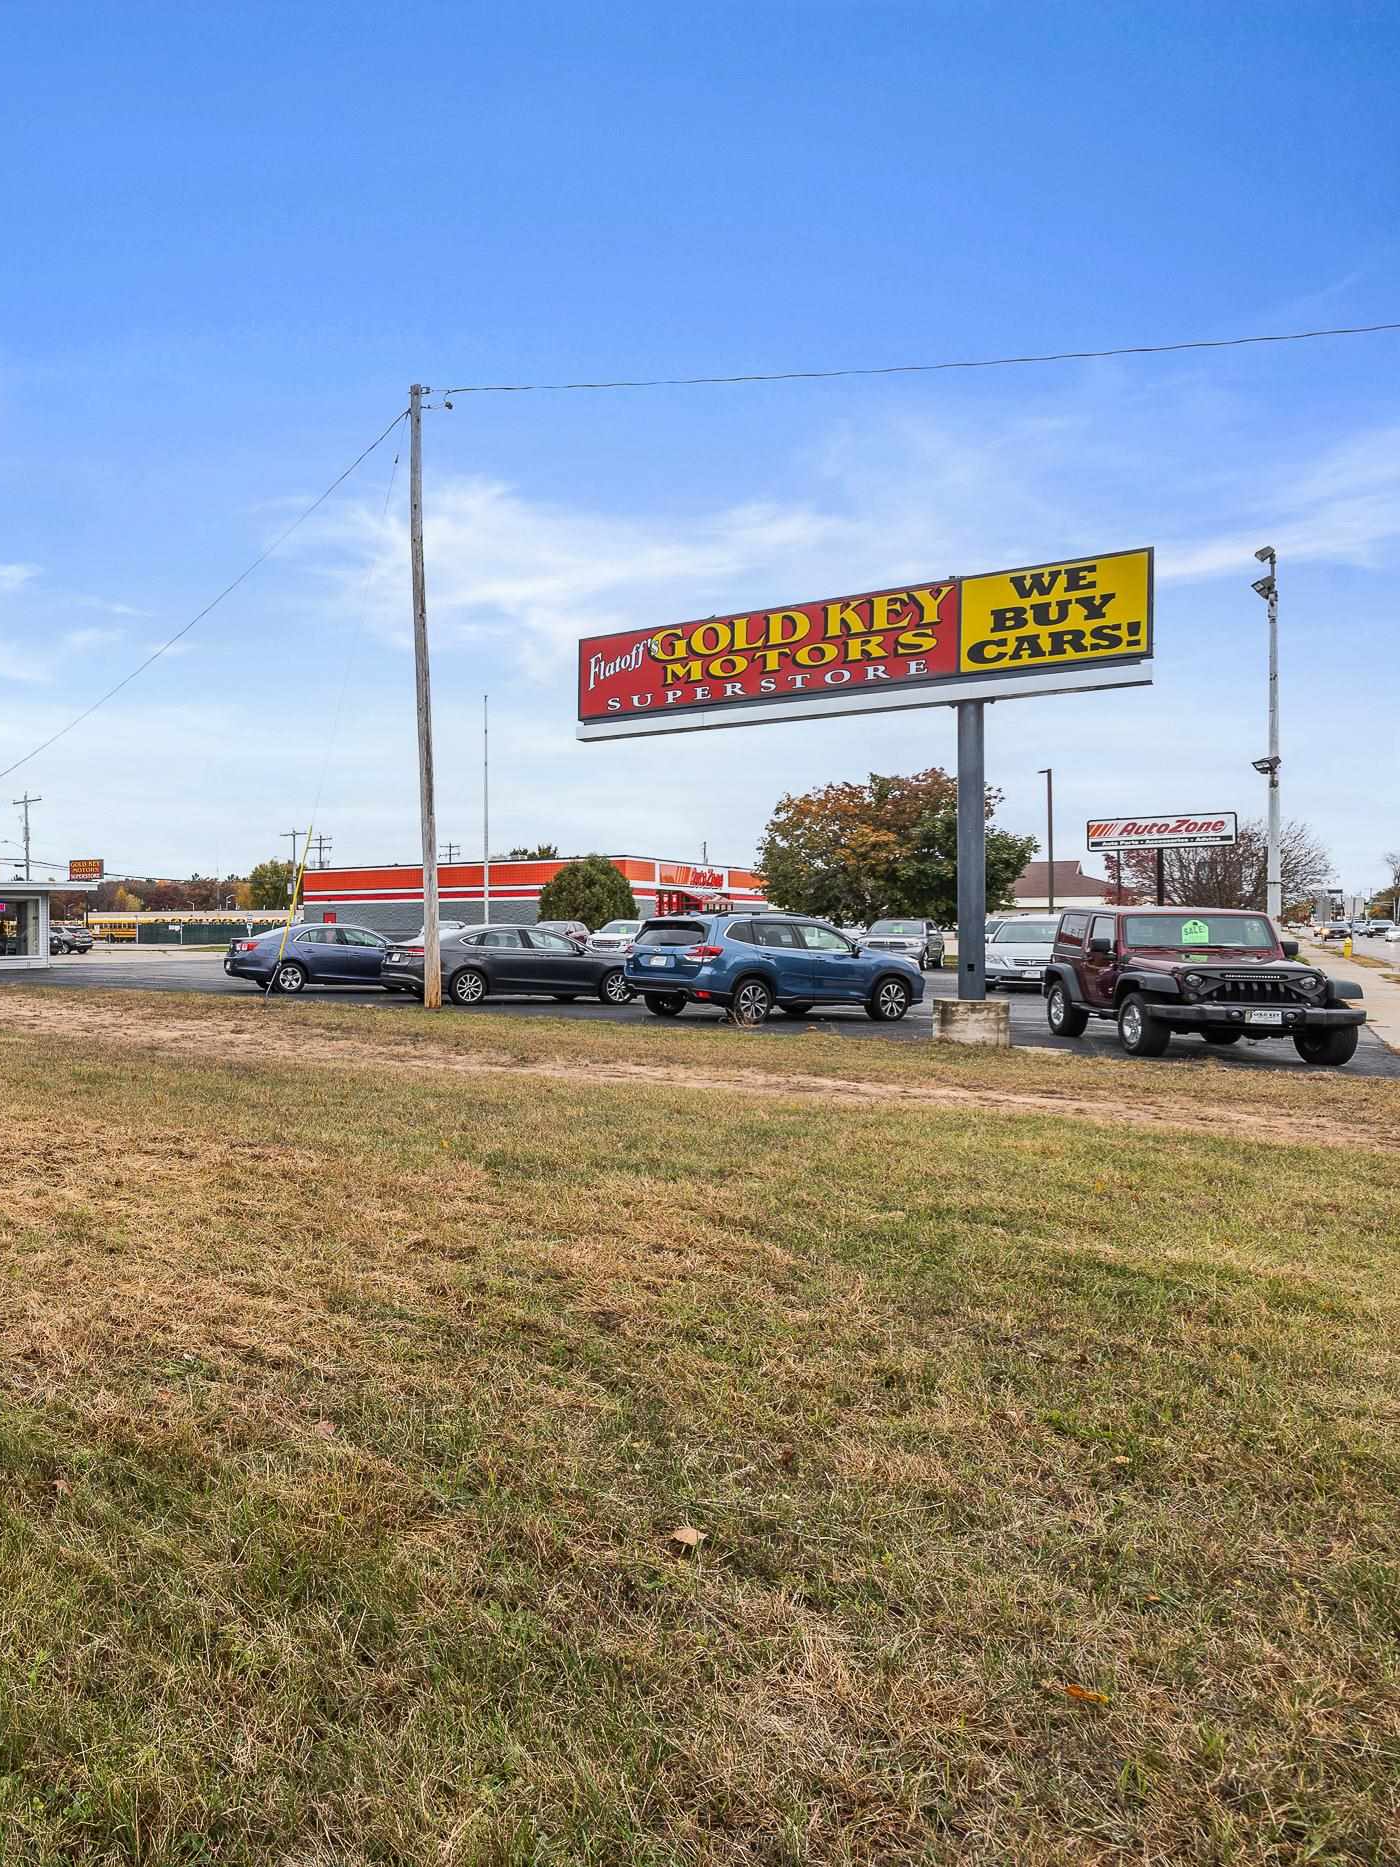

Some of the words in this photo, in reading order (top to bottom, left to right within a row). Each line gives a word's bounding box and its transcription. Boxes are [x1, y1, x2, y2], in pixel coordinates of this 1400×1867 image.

[1009, 564, 1097, 599] WE
[650, 608, 812, 662] GOLD
[822, 584, 956, 640] KEY
[990, 592, 1116, 634] BUY
[587, 637, 660, 691] Flatoff's
[663, 628, 940, 687] MOTORS
[966, 621, 1142, 665] CARS!
[607, 658, 929, 712] SUPERSTORE
[1119, 819, 1225, 836] AutoZone
